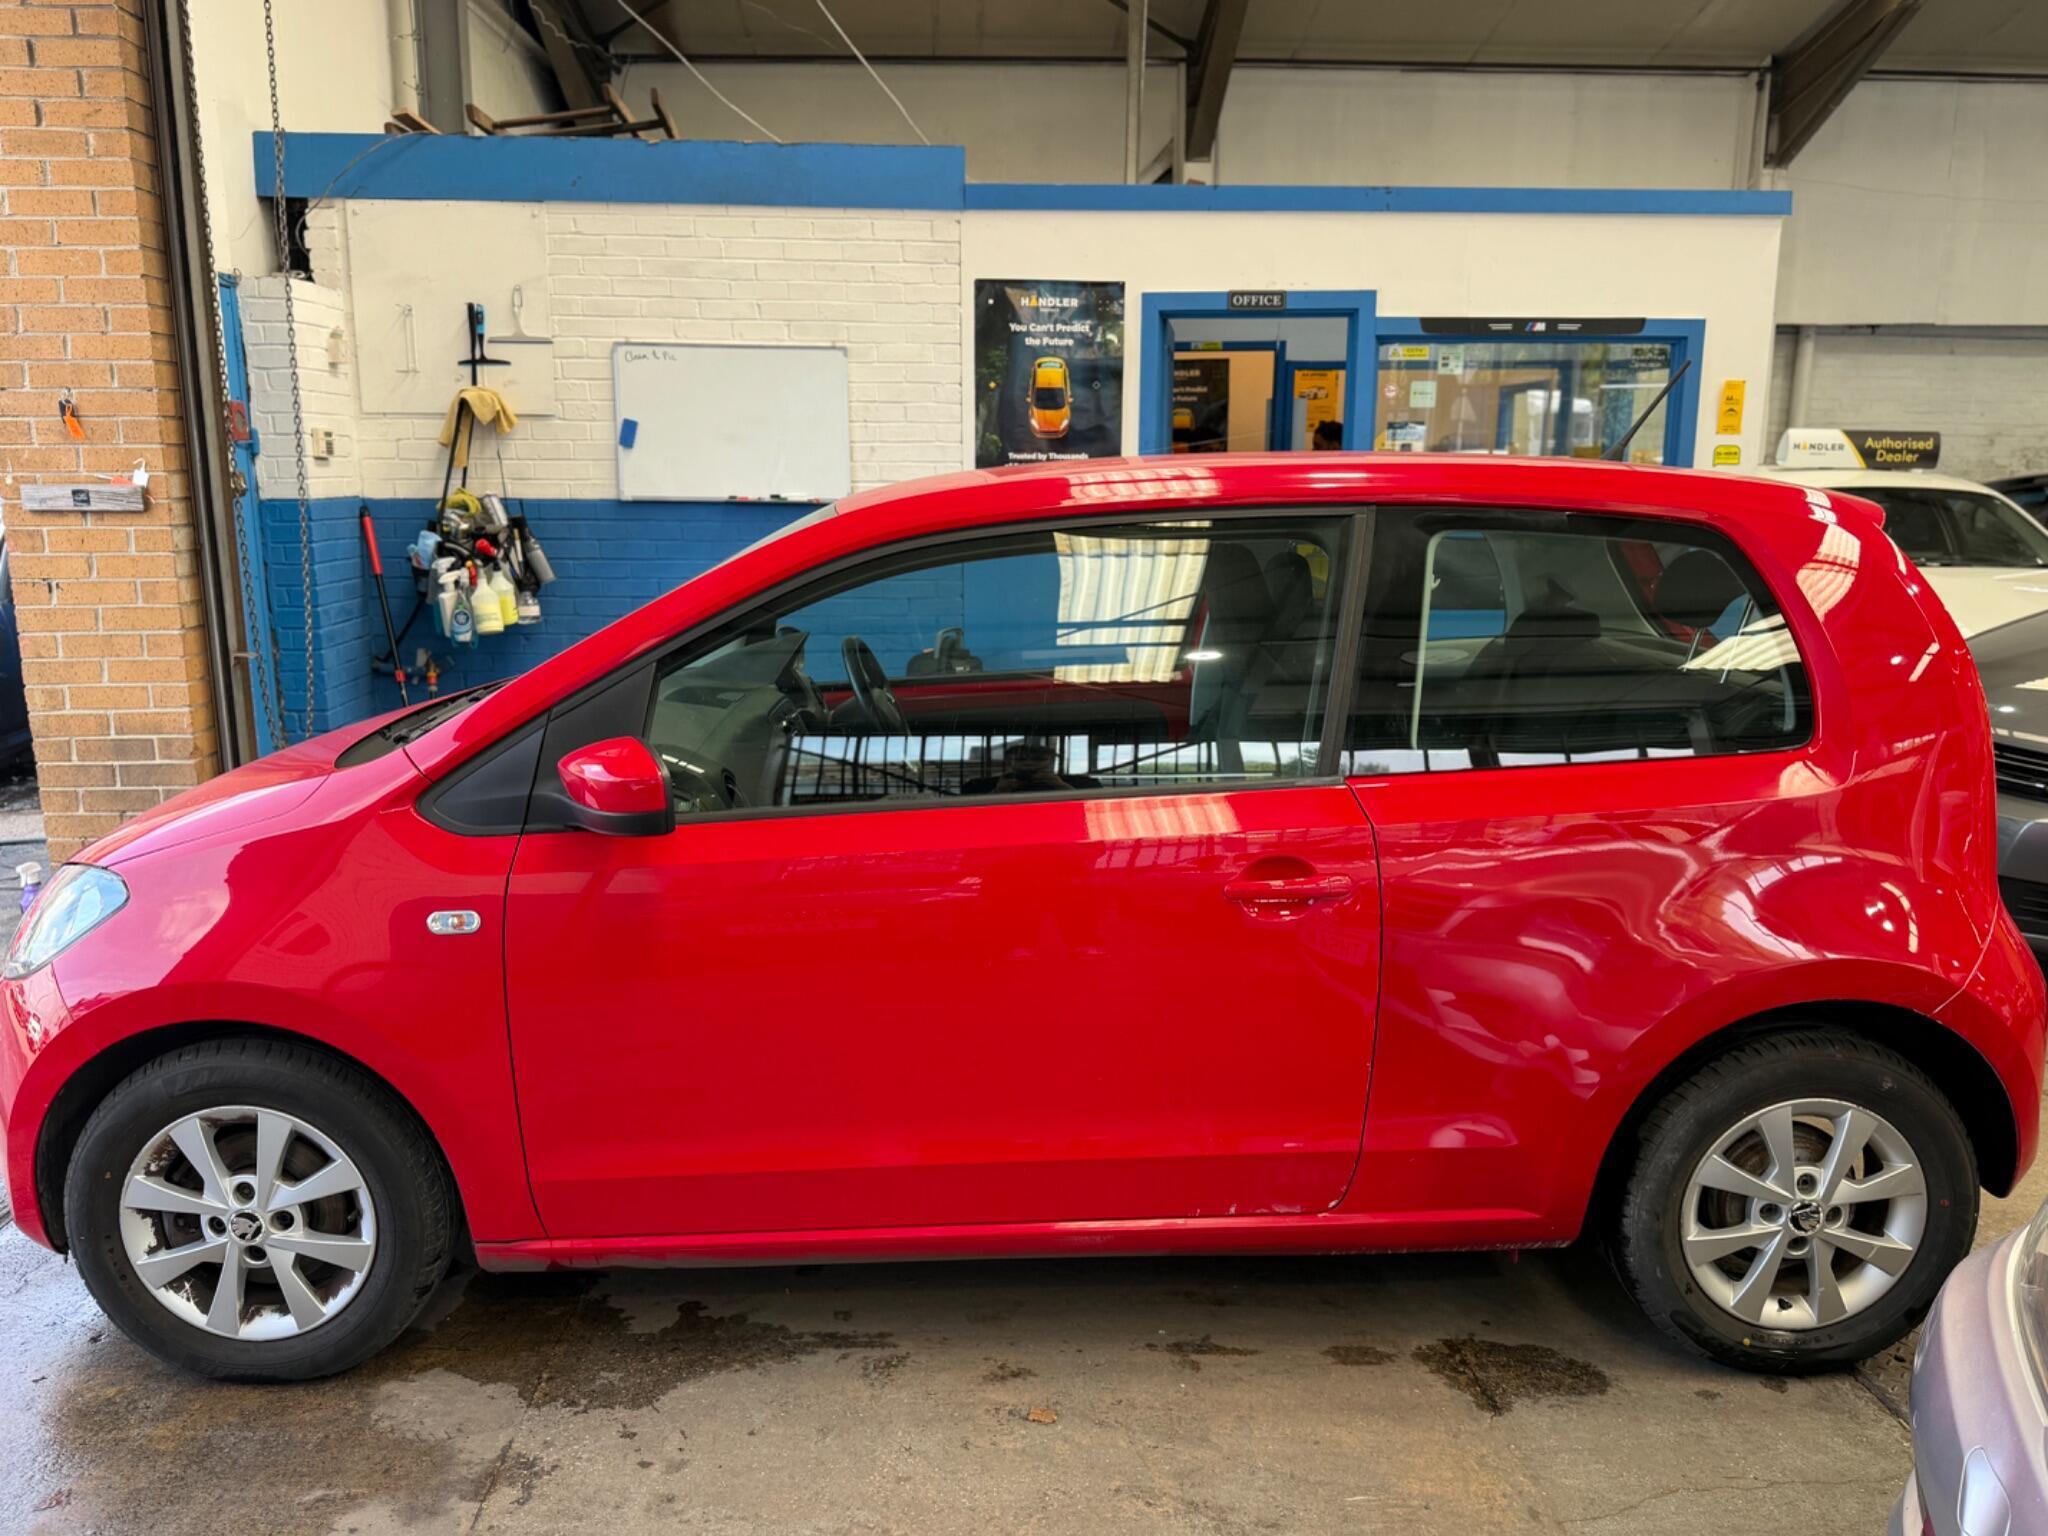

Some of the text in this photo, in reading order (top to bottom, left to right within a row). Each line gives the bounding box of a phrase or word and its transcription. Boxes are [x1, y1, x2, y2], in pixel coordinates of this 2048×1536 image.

[1021, 296, 1078, 308] HANDLER
[1233, 295, 1281, 306] OFFICE
[1009, 323, 1089, 332] You Can't Predict
[1025, 337, 1074, 345] the Future
[1174, 369, 1201, 377] NDLER
[1793, 441, 1845, 451] HANDLER
[1864, 437, 1934, 450] Authorised
[1008, 452, 1089, 461] Trusted by Thousands
[1876, 450, 1919, 462] Dealer
